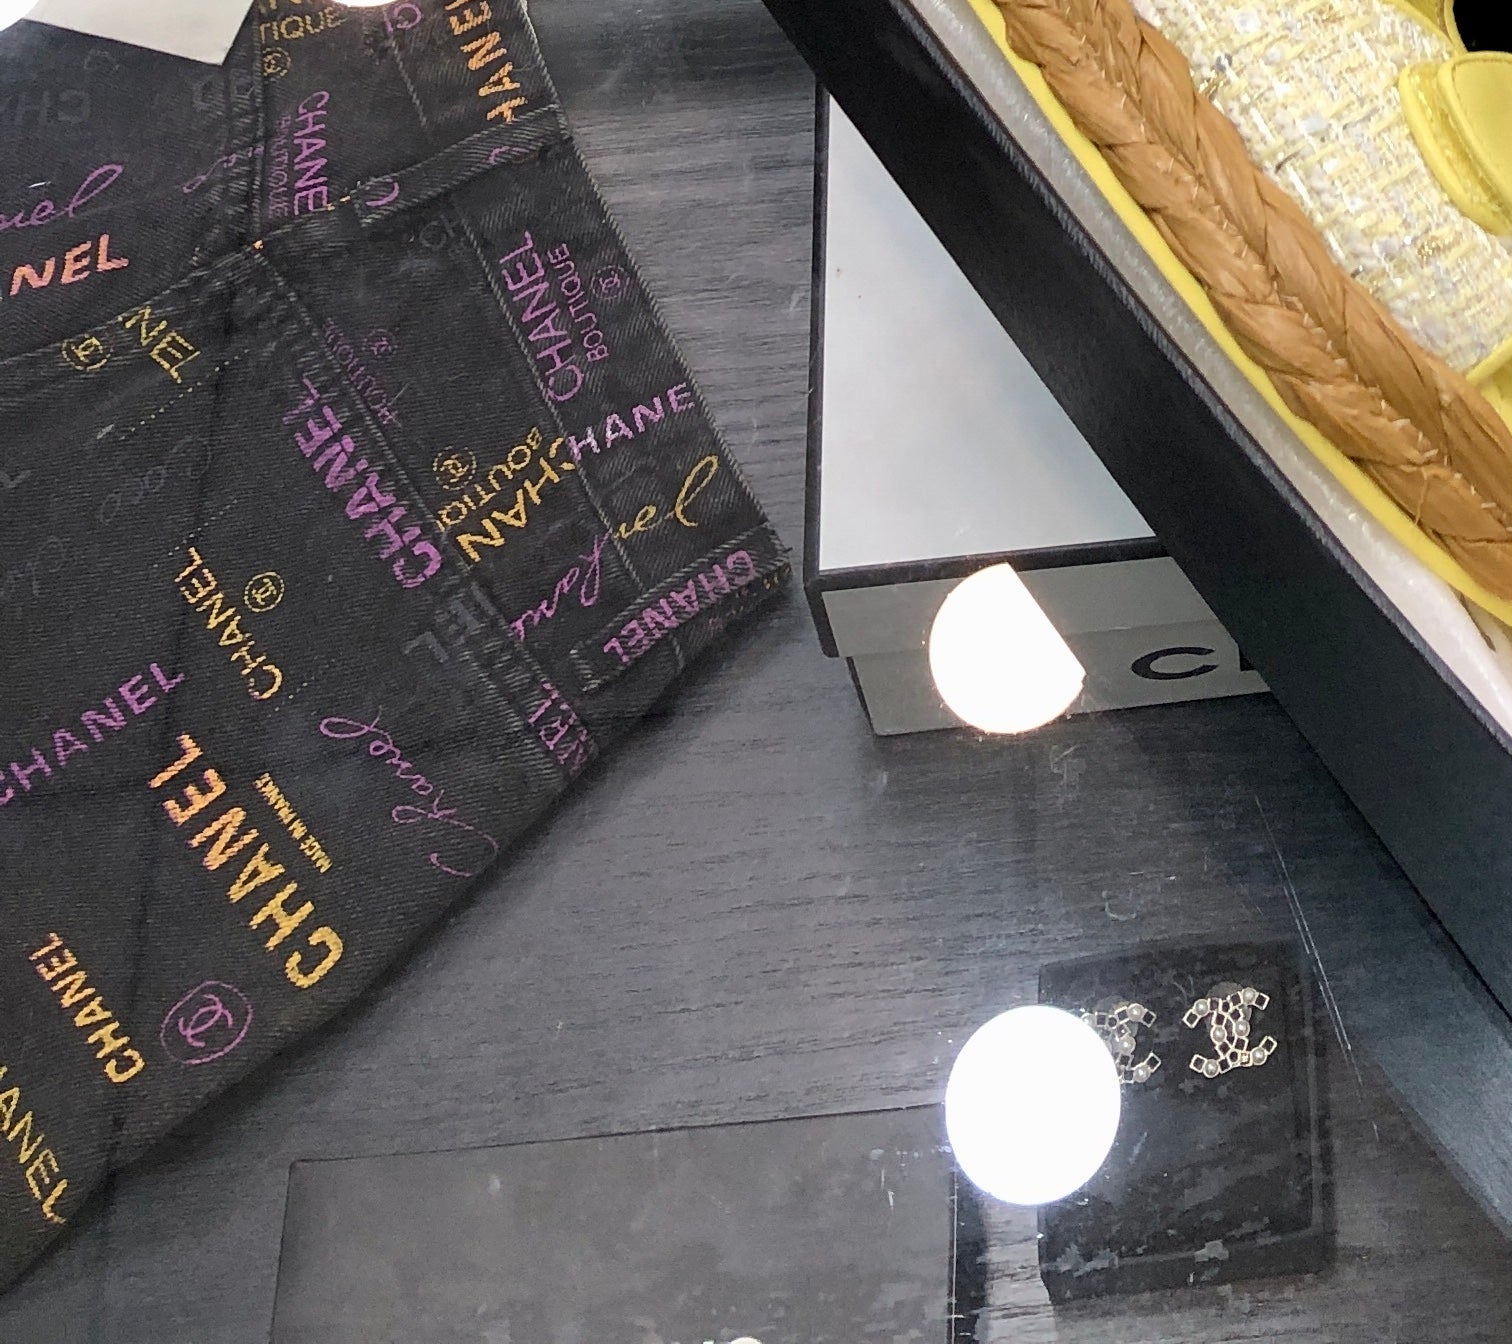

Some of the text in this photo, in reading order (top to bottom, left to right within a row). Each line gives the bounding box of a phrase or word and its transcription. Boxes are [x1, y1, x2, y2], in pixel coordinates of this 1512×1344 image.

[499, 230, 585, 403] CHANEL
[547, 243, 610, 362] BOUTIQUE
[282, 377, 442, 588] CHANEL
[174, 546, 283, 700] CHANEL
[603, 549, 757, 663] CHANEL
[149, 732, 344, 989] CHANEL
[28, 932, 145, 1083] CHANEL
